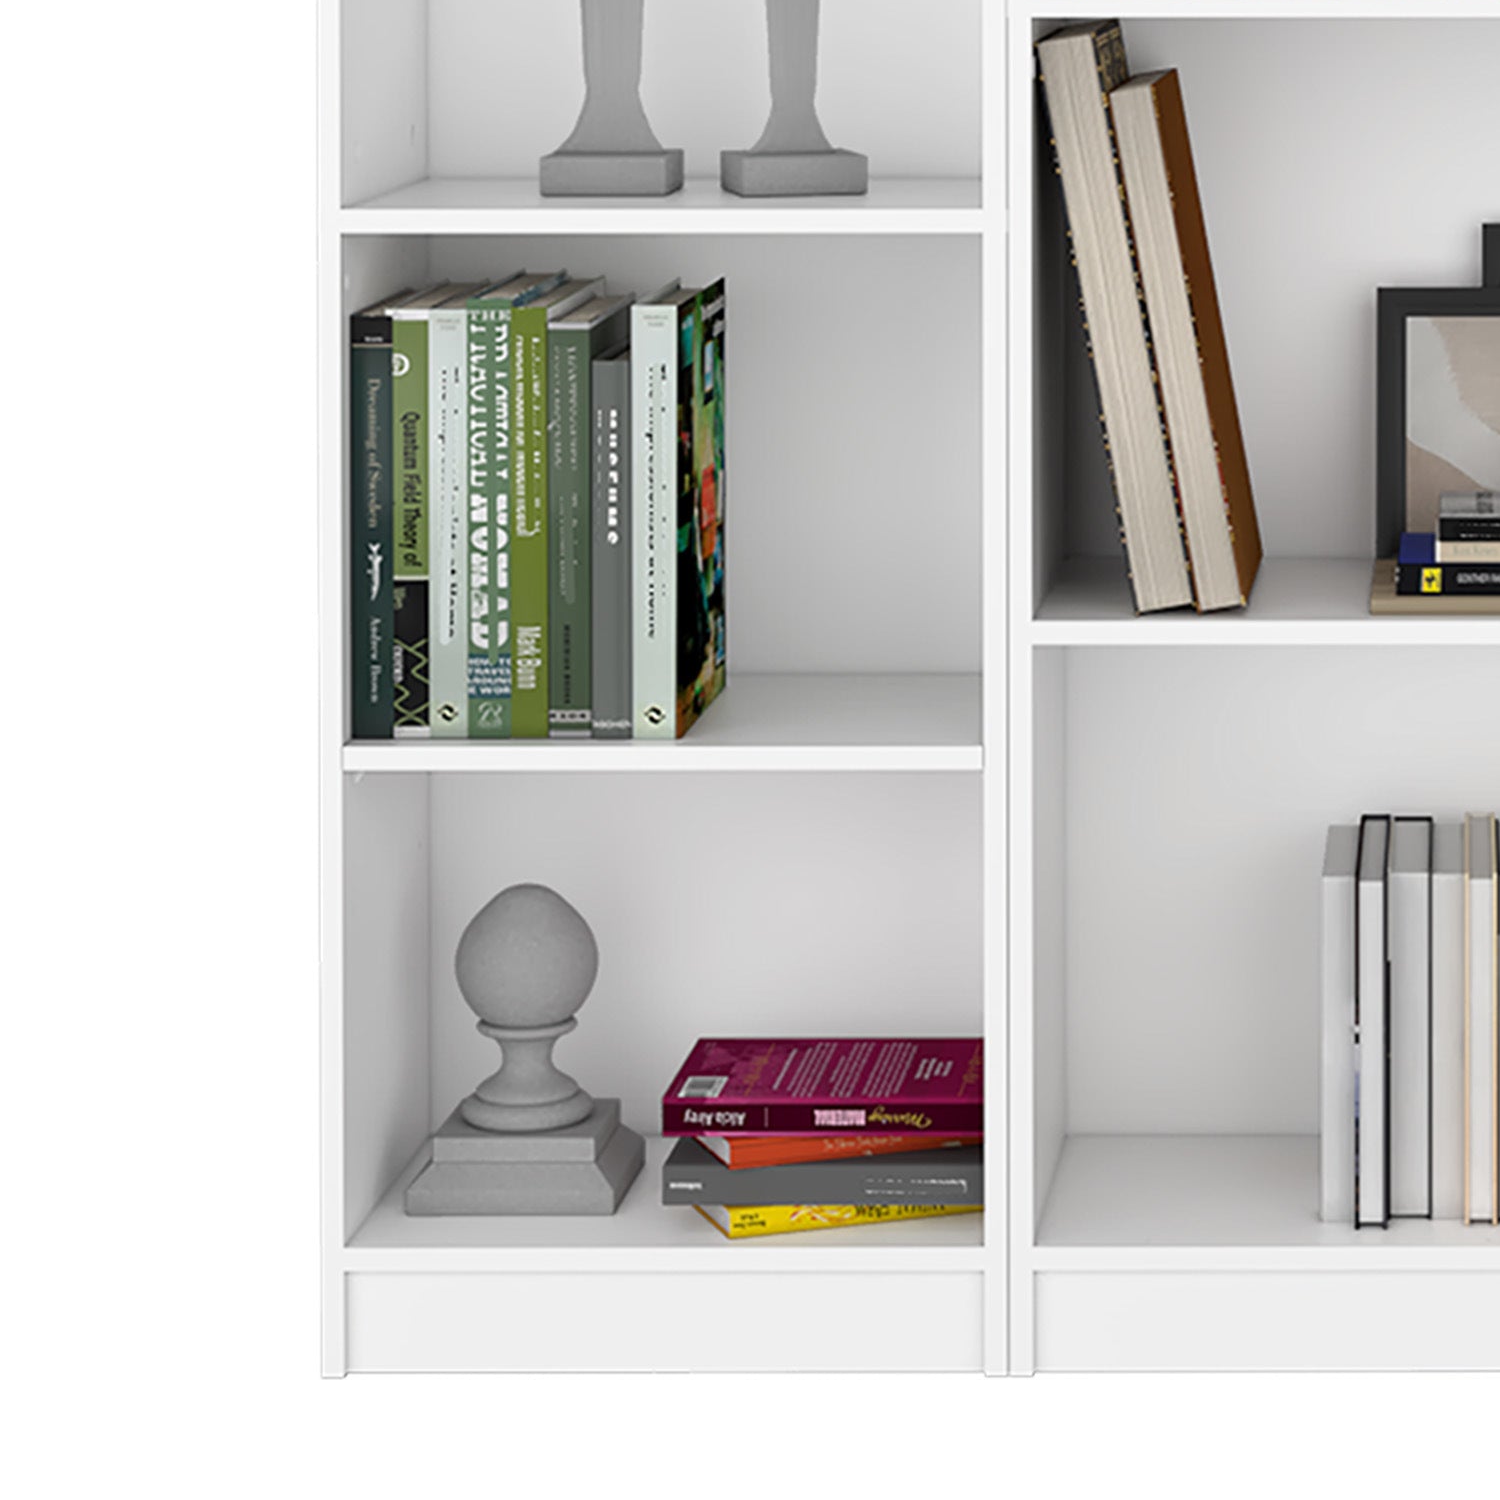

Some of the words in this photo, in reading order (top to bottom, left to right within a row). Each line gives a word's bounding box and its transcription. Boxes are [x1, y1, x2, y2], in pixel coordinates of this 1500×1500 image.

[400, 411, 421, 469] Quantum
[402, 473, 421, 504] Field
[399, 507, 422, 550] Theory
[404, 553, 421, 567] of
[470, 493, 508, 650] NOMAD
[516, 626, 542, 657] Mark
[516, 659, 542, 690] Bunn
